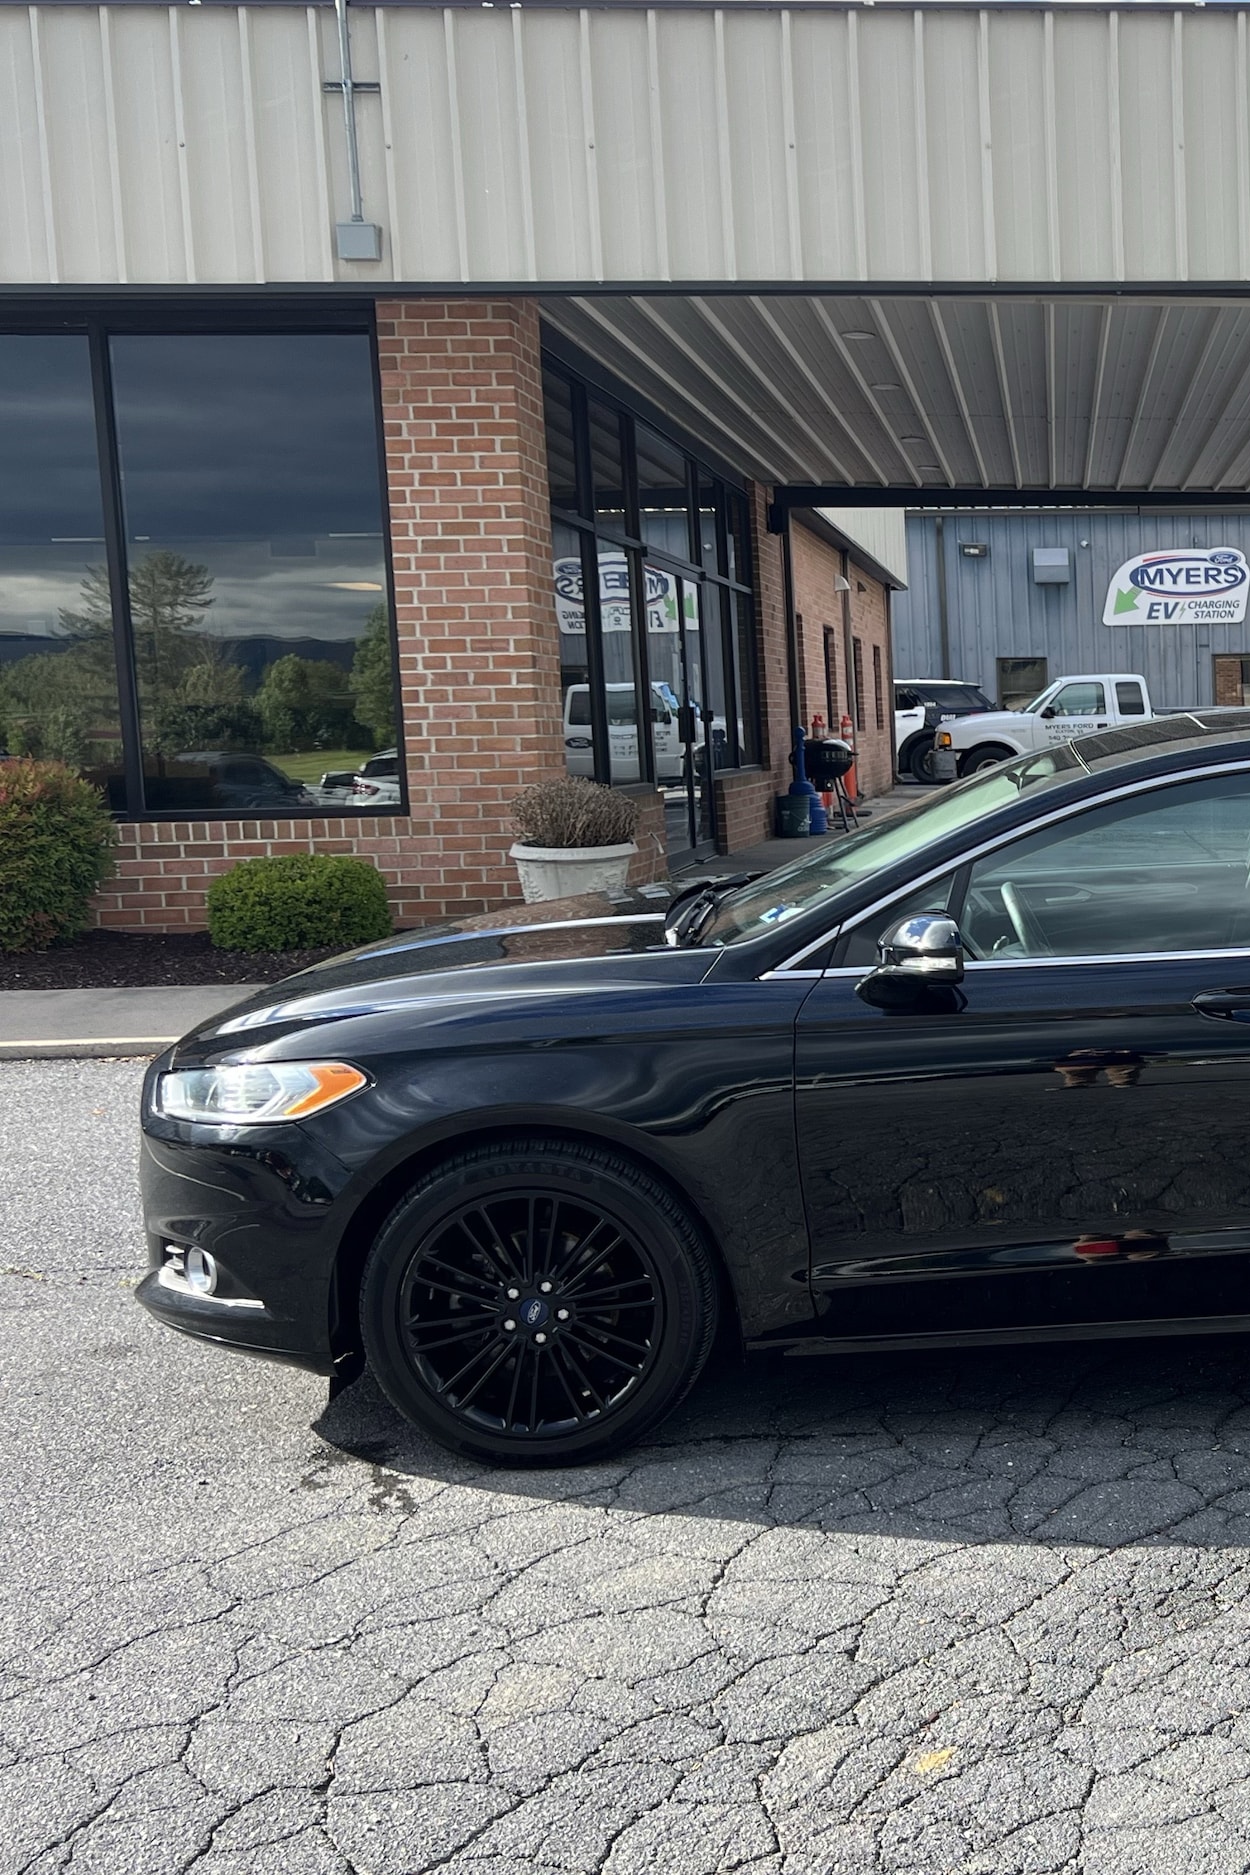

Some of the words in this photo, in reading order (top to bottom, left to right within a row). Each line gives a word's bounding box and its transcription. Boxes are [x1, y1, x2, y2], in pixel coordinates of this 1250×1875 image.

[1214, 554, 1233, 564] Ford
[1140, 566, 1239, 585] MYERS
[1188, 600, 1240, 609] CHARGING
[1147, 602, 1180, 620] EV
[1194, 610, 1235, 619] STATION
